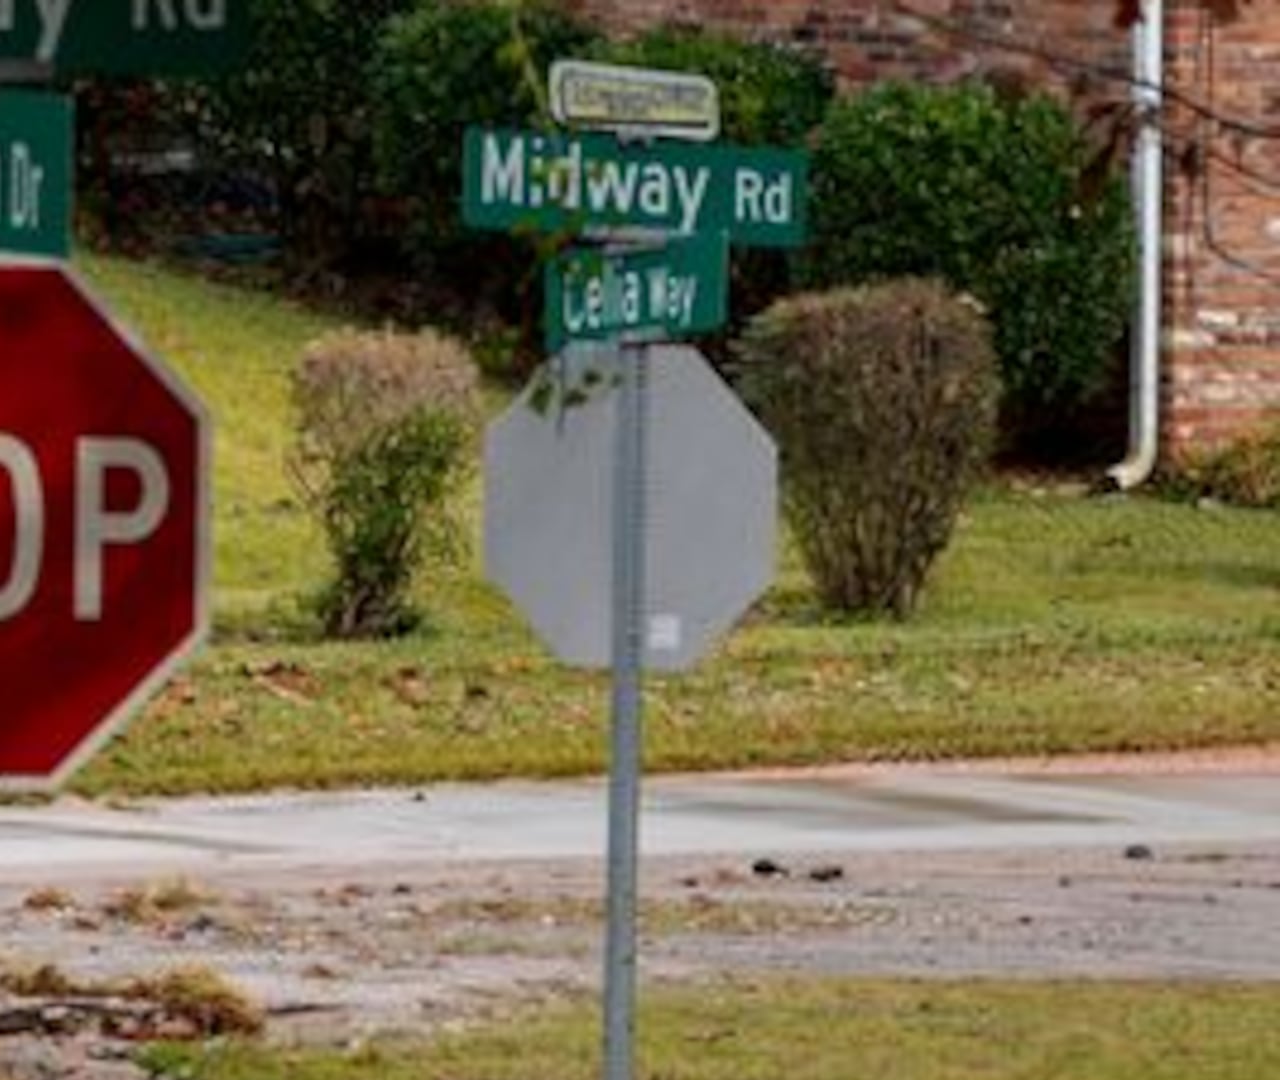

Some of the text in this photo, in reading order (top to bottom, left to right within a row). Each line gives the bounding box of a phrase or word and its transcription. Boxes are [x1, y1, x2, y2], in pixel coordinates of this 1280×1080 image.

[11, 138, 44, 228] Dr
[481, 132, 791, 234] Midway Rd
